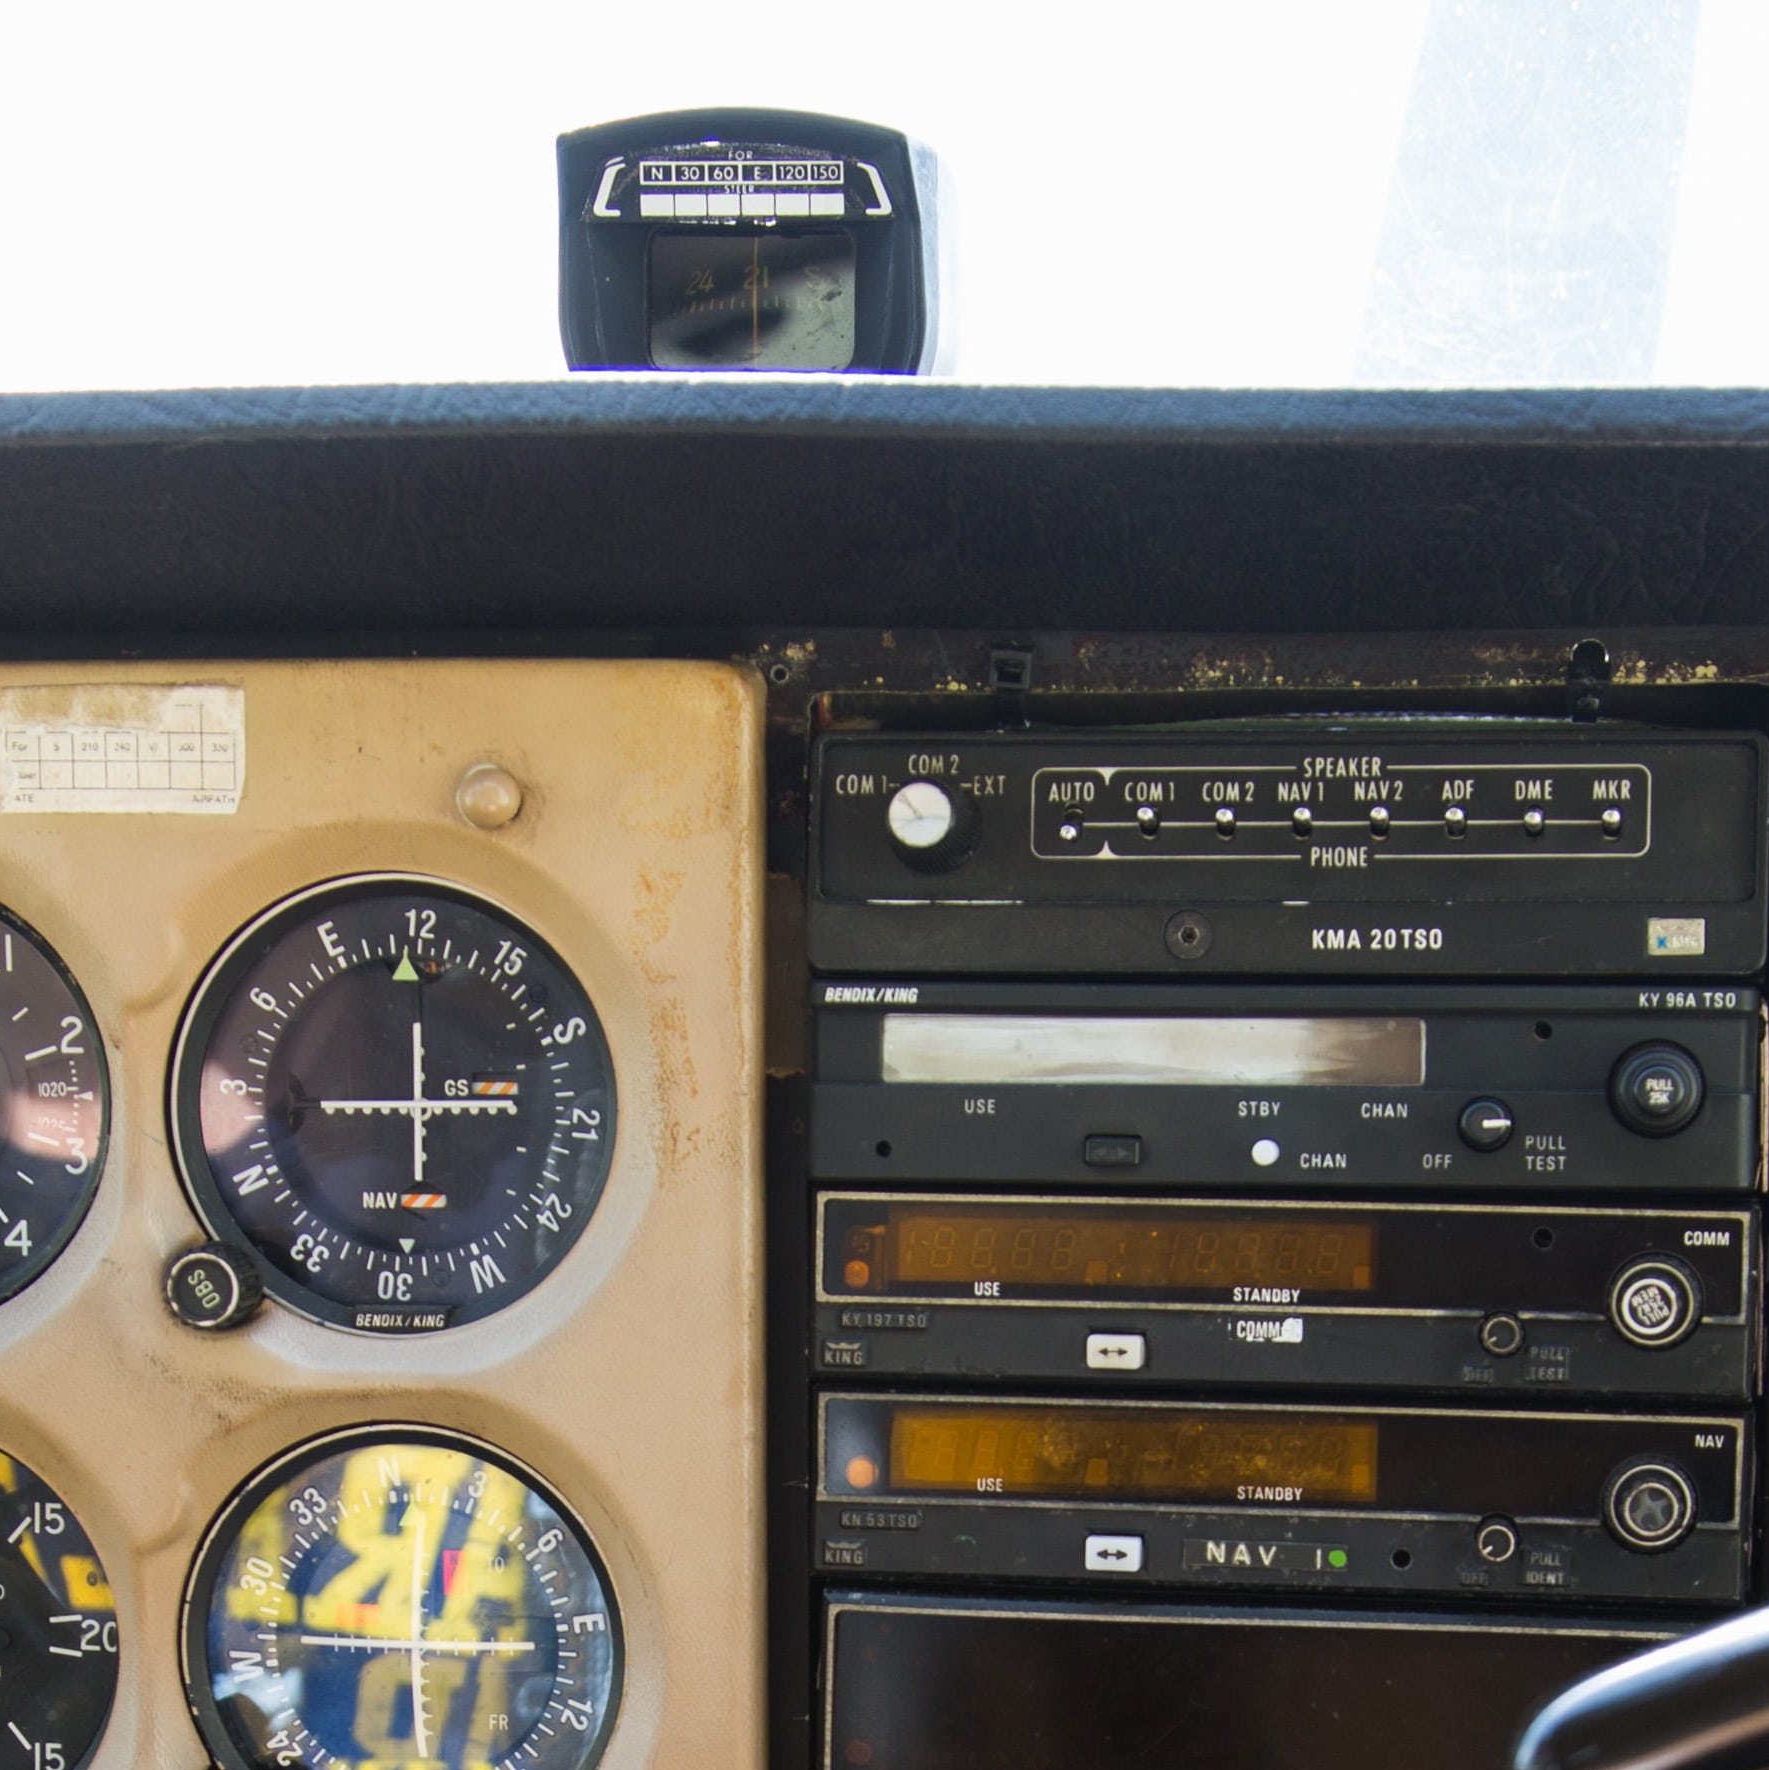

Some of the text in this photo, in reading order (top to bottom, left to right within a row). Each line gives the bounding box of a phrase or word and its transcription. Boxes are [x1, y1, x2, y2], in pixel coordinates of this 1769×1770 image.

[729, 151, 753, 161] FOR
[681, 167, 700, 180] 30
[714, 167, 734, 180] 60
[780, 166, 805, 180] 120
[813, 165, 838, 179] 150
[1304, 757, 1382, 778] SPEAKER
[1049, 780, 1630, 801] AUTO COM 1 COM 2 NAV 1 NAV 2 ADF DME MKR
[1311, 847, 1368, 867] PHONE
[1312, 929, 1361, 950] KMA
[825, 987, 918, 1003] BENDIX/KING
[1639, 993, 1736, 1008] KY 96A TSO
[965, 1099, 995, 1114] USE
[1239, 1102, 1280, 1116] STBY
[1361, 1104, 1408, 1118] CHAN
[1525, 1136, 1566, 1150] PULL
[1300, 1154, 1347, 1168] CHAN
[1423, 1154, 1452, 1168] OFF
[1526, 1156, 1566, 1170] TEST
[1684, 1231, 1729, 1246] COMM
[975, 1282, 1000, 1296] USE
[1233, 1287, 1300, 1302] STANDBY
[1695, 1435, 1724, 1449] NAV
[977, 1479, 1002, 1492] USE
[1237, 1486, 1302, 1502] STANDBY
[1207, 1542, 1276, 1567] NAV
